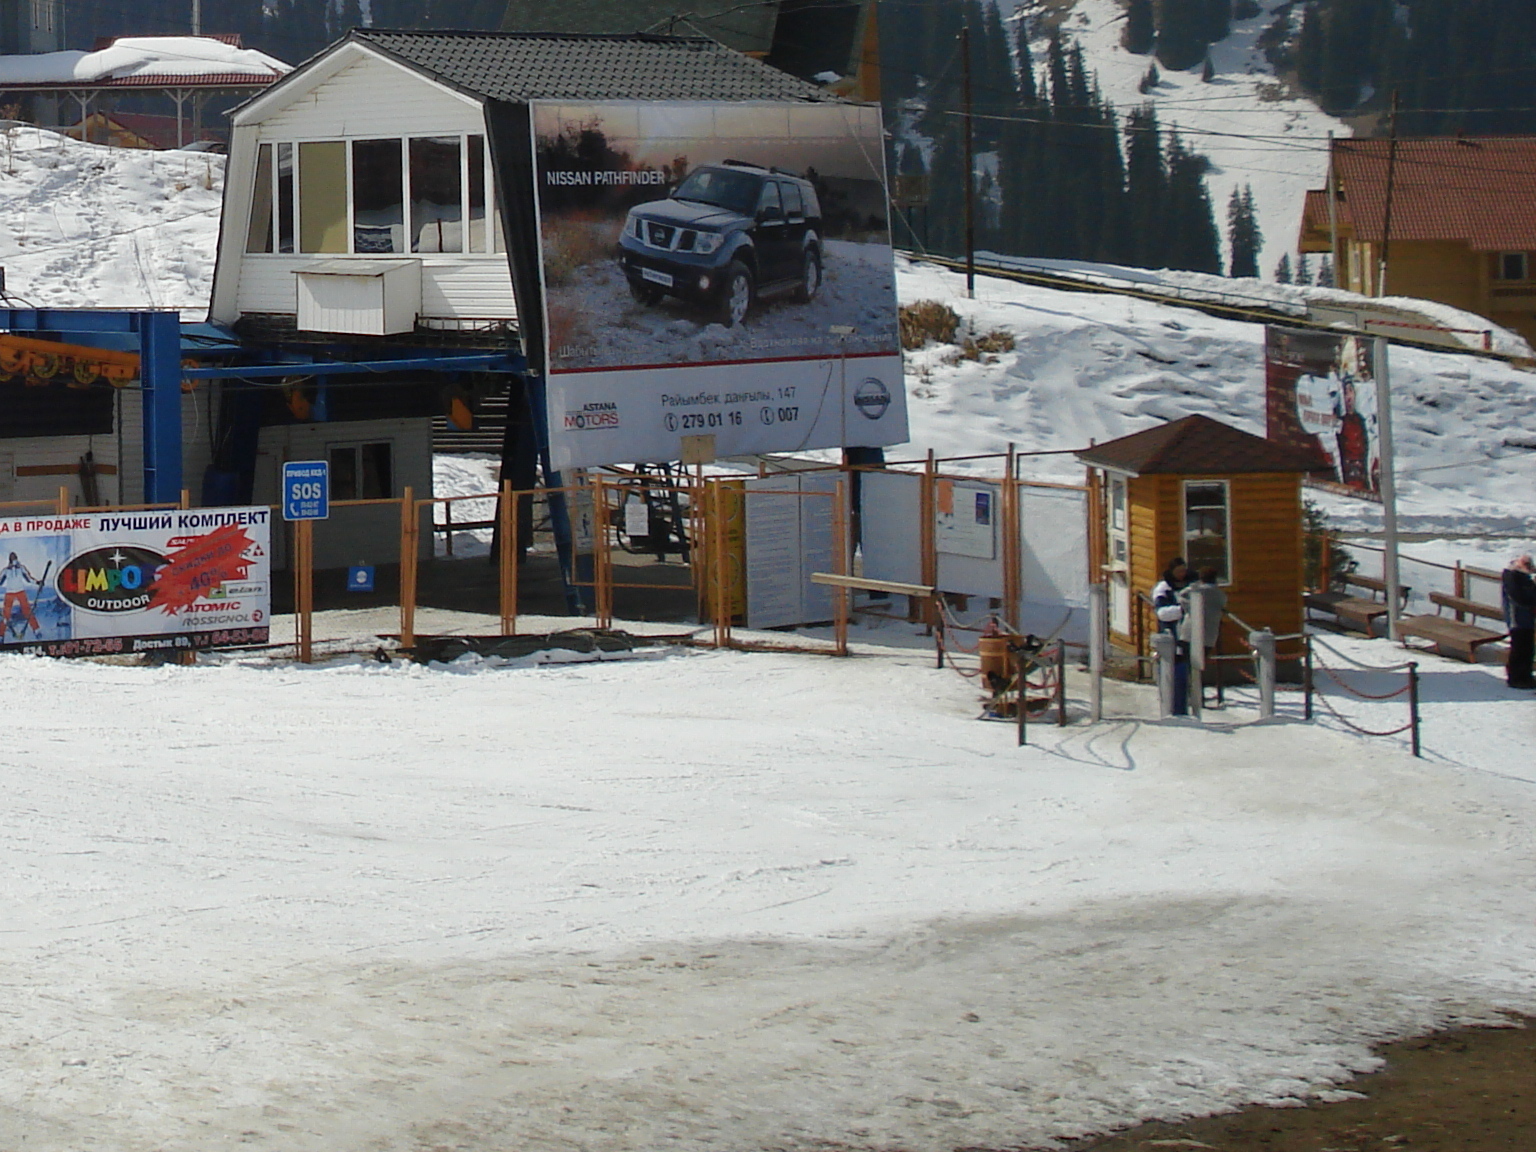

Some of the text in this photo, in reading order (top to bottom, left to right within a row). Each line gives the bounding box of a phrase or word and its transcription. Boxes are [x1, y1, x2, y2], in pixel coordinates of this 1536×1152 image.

[547, 170, 665, 186] NISSAN PATHFINDER
[778, 386, 796, 399] 147
[583, 401, 617, 412] ASTANA
[564, 412, 619, 429] MOTORS
[681, 407, 799, 429] 279 01 16 007
[291, 482, 322, 500] SOS
[13, 521, 22, 532] В
[26, 518, 91, 532] ПРОДАЖЕ
[99, 513, 172, 532] ЛУЧШИЙ
[178, 511, 269, 528] КОМПЛЕКТ
[87, 594, 151, 610] OUTDOOR
[183, 601, 241, 614] ATOMIC
[182, 613, 250, 627] ROSSIGNOL
